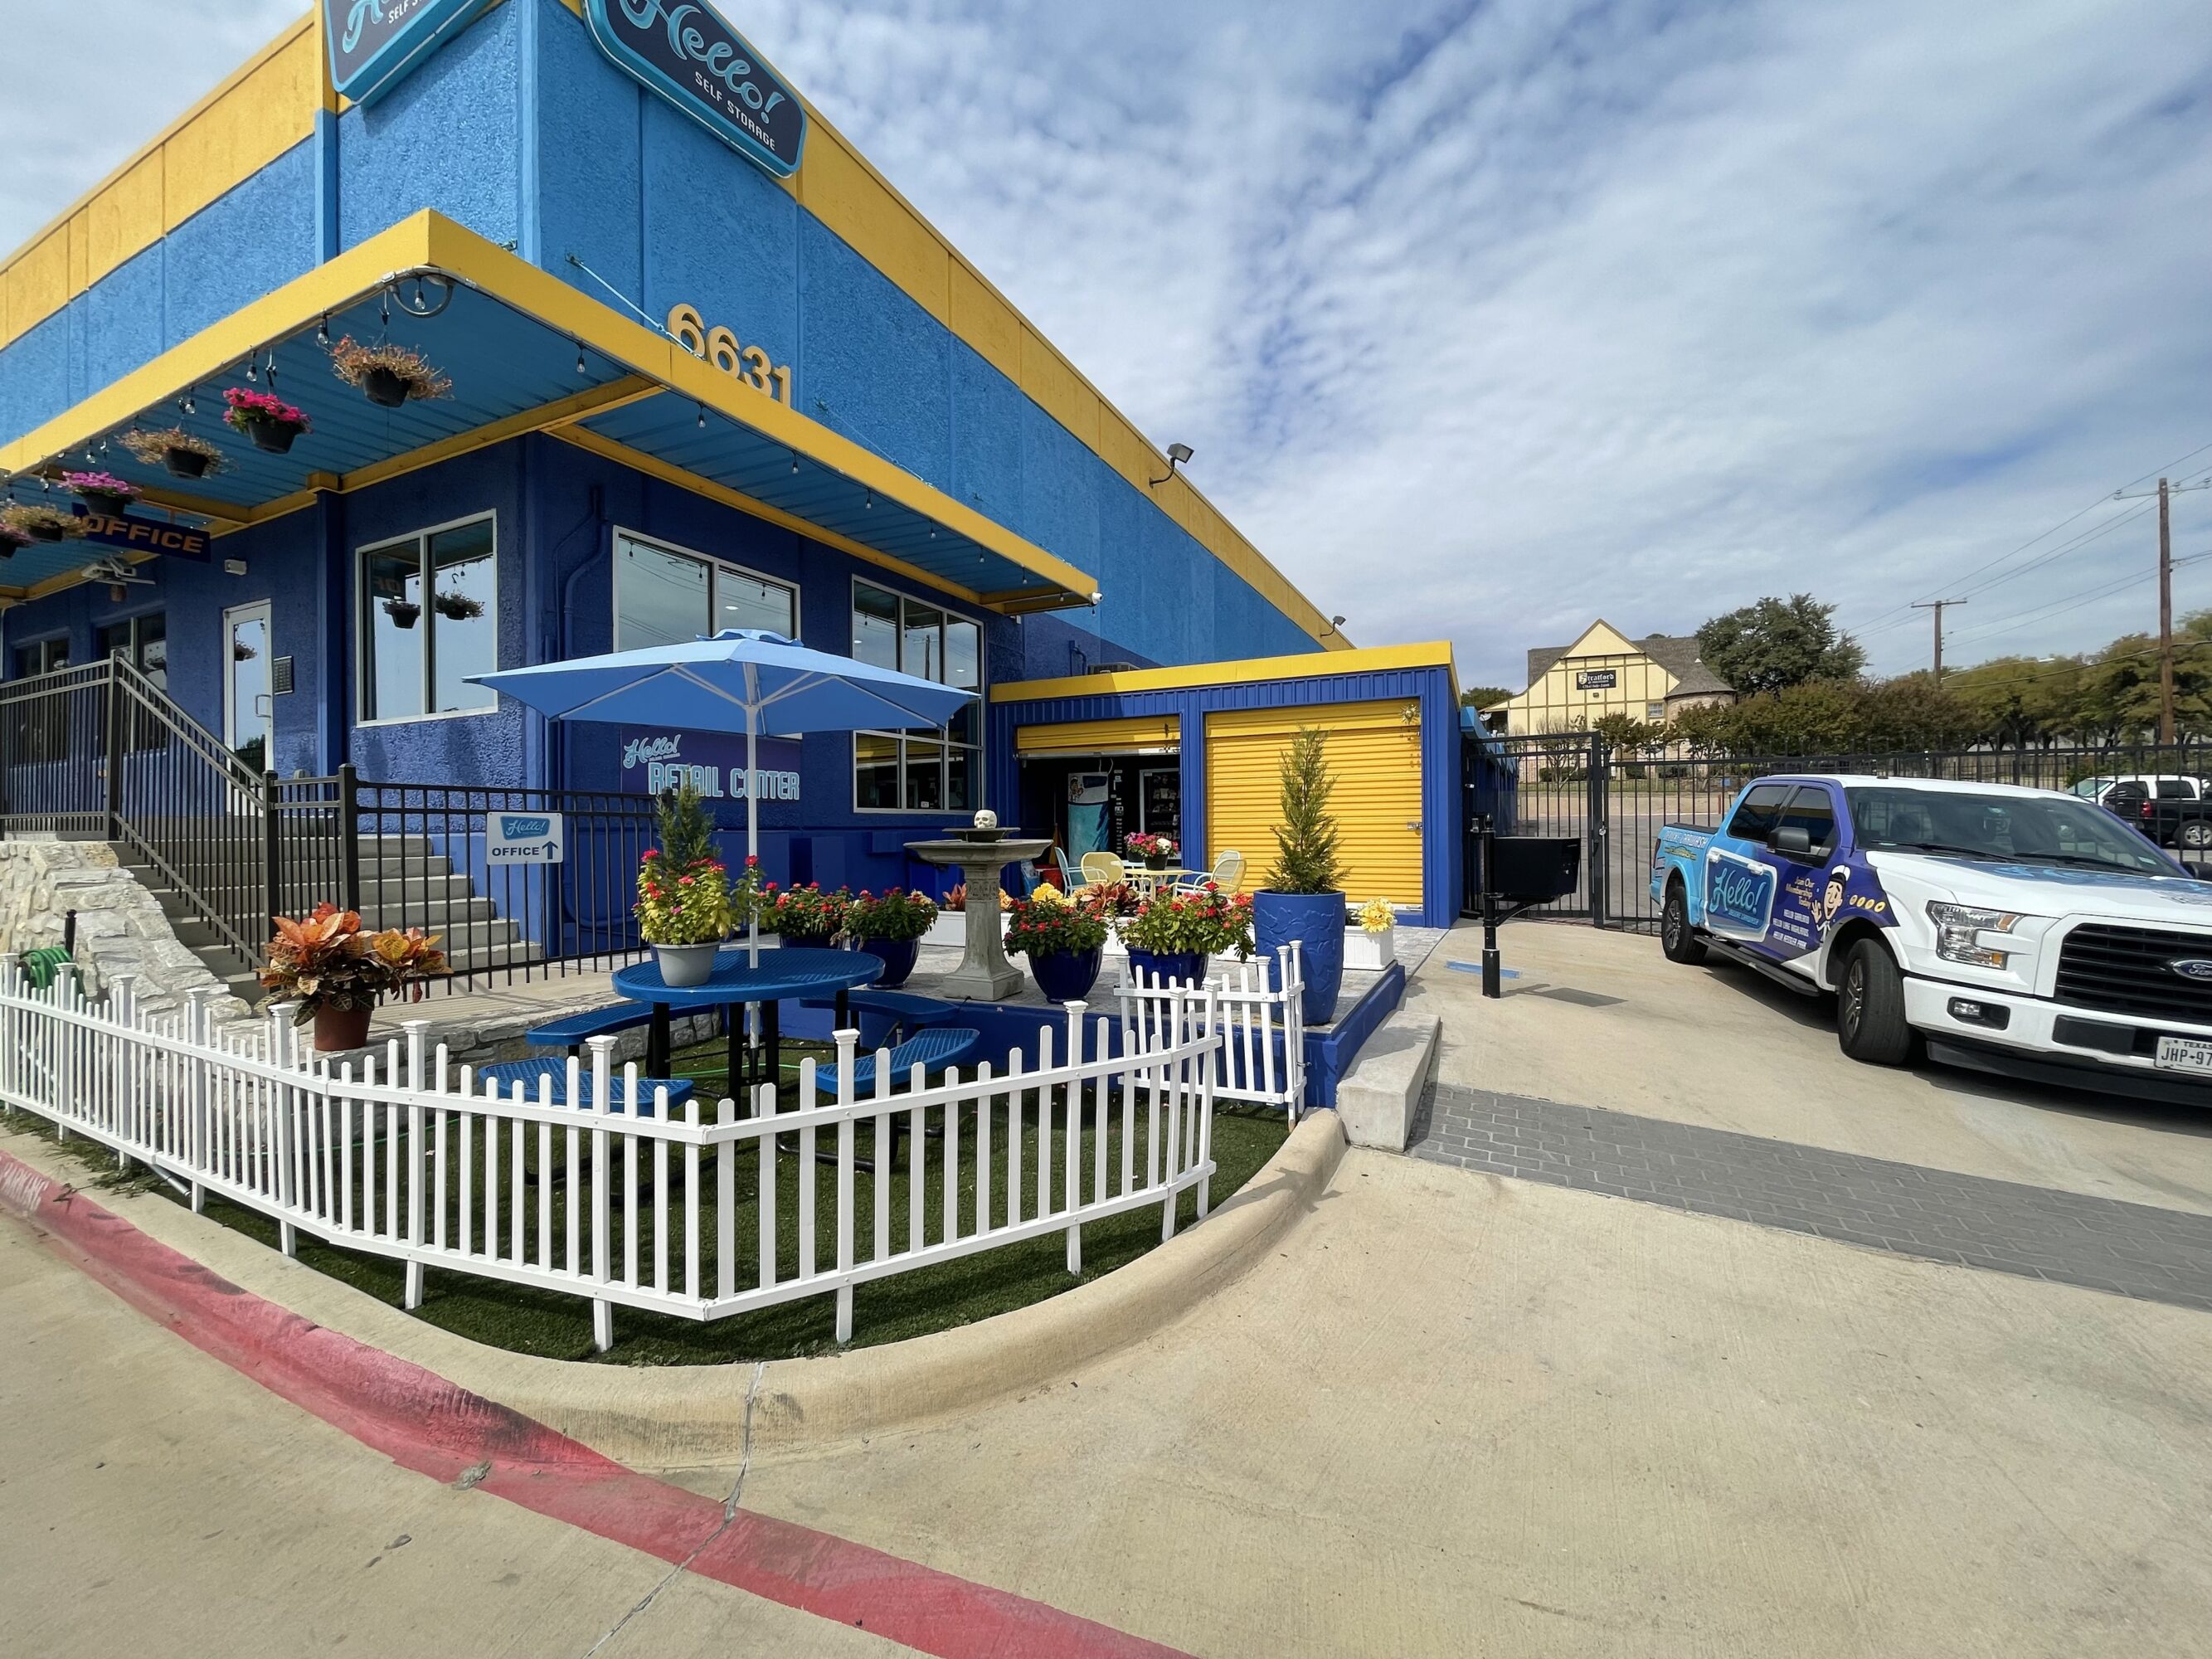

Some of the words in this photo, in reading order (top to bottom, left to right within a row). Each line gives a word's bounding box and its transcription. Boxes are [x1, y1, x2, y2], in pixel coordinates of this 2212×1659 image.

[695, 71, 722, 102] SELF
[727, 100, 775, 152] STORAGE
[668, 303, 790, 408] 6631
[81, 516, 204, 553] OFFICE
[623, 734, 681, 769] Hello!
[505, 820, 547, 836] Hello!
[492, 847, 540, 856] OFFICE
[1709, 868, 1767, 914] Hello!
